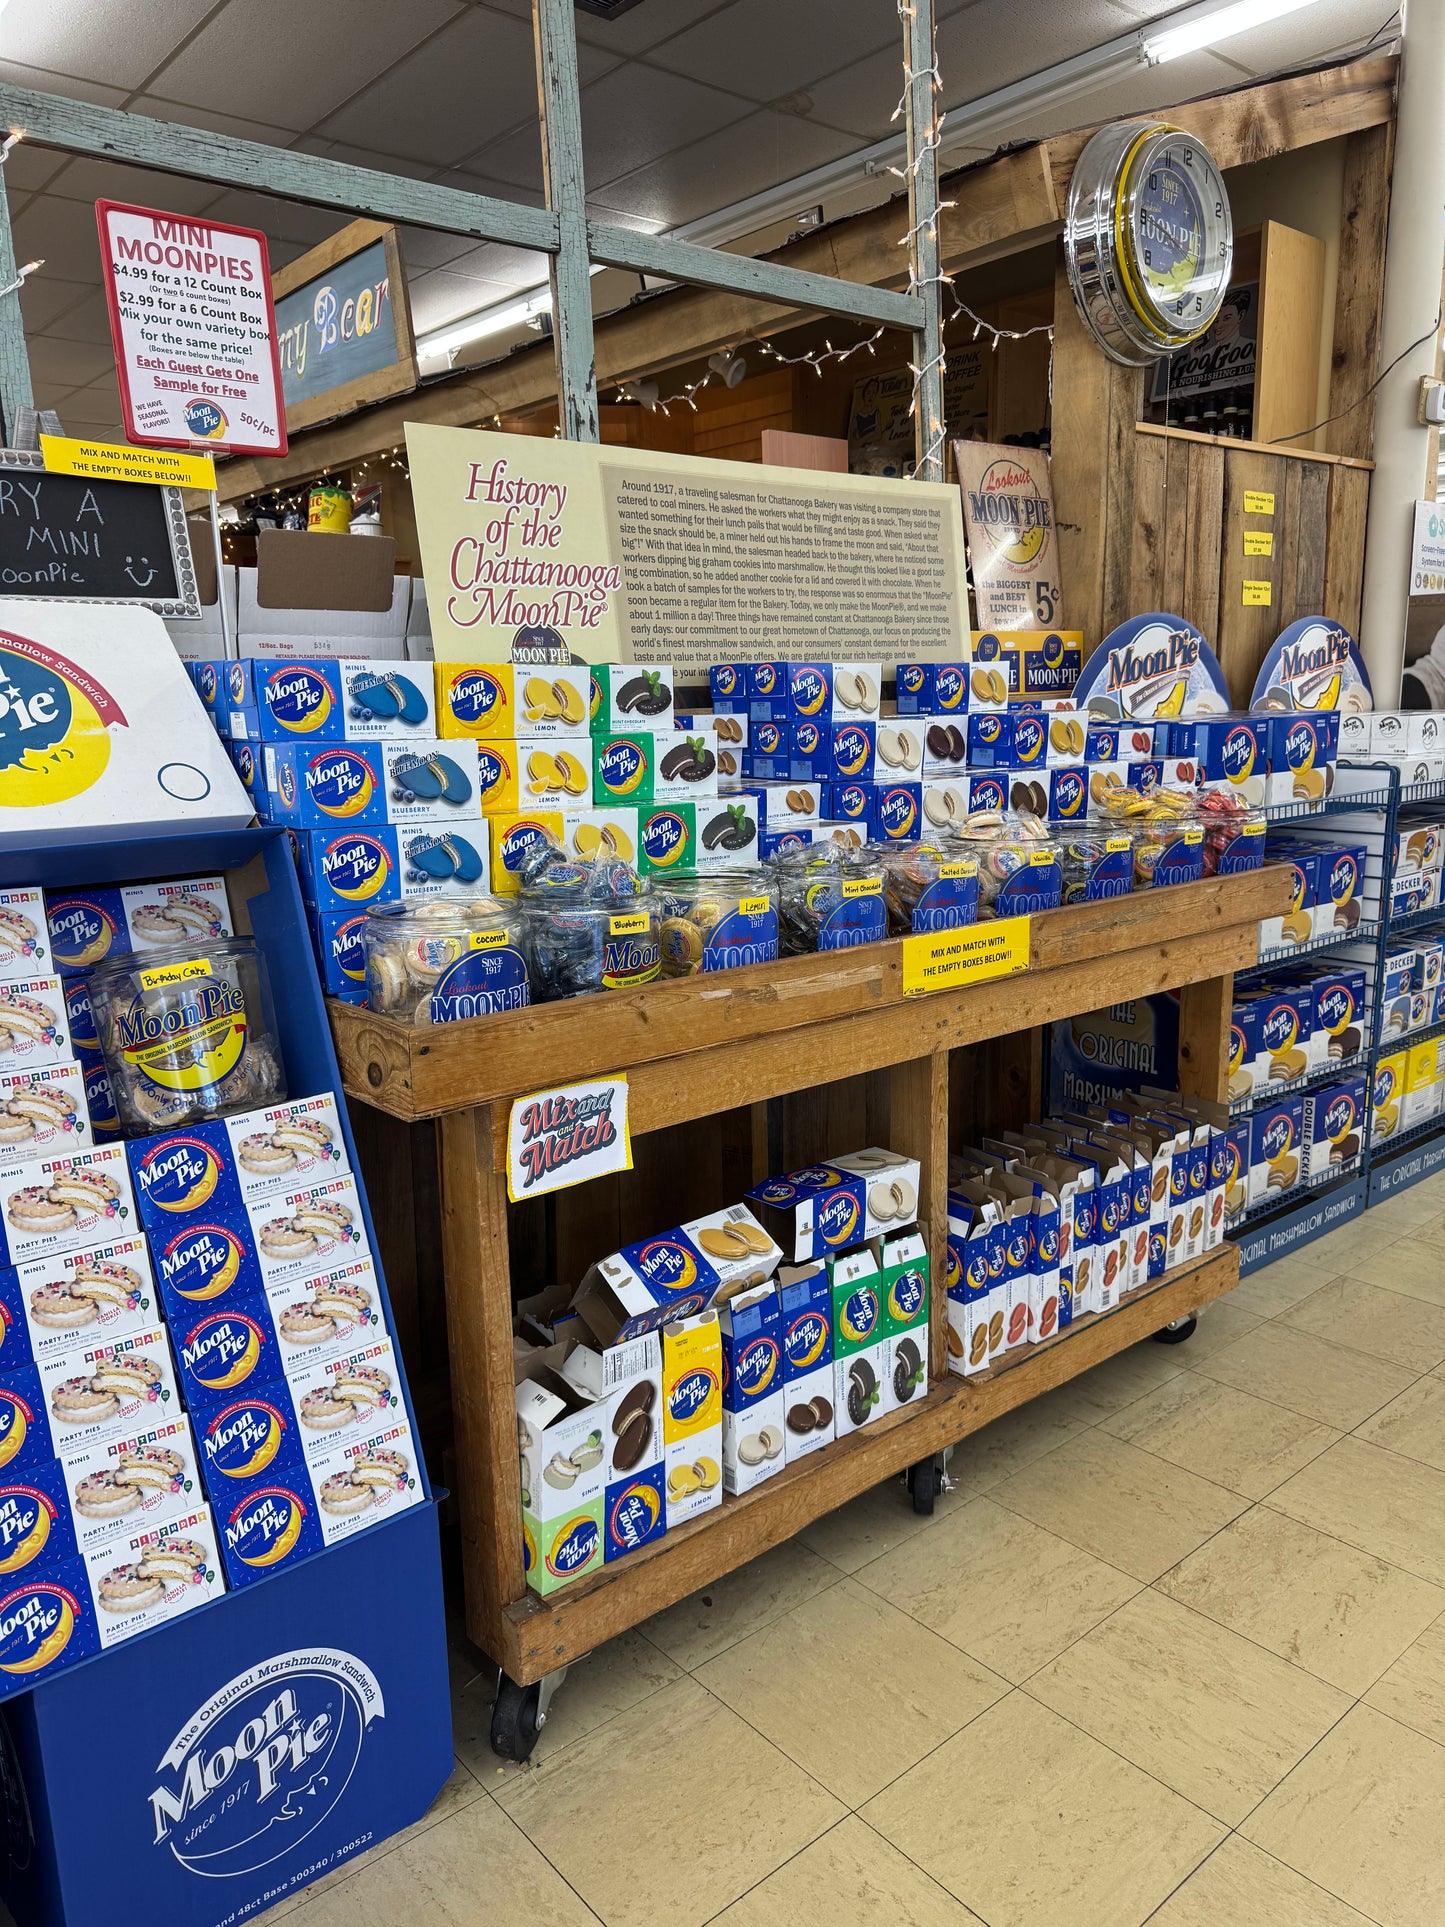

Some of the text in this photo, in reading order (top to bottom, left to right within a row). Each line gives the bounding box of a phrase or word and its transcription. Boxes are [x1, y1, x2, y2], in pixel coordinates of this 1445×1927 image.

[1183, 148, 1193, 168] 12
[1161, 174, 1180, 193] SINCE
[1162, 190, 1178, 206] 1917
[1215, 201, 1222, 218] 2
[1140, 208, 1147, 225] 9
[152, 219, 213, 249] MINI
[117, 236, 254, 282] MOONPIES
[113, 263, 262, 300] $4.99 for a 12 Count Box
[120, 291, 262, 325] $2.99 for a 6 Count Box
[150, 285, 162, 293] (Or
[163, 288, 178, 297] two
[186, 291, 207, 301] count
[208, 294, 231, 306] boxes)
[1176, 300, 1184, 316] 6
[1195, 297, 1202, 313] 5
[118, 306, 270, 340] Mix your own variety box
[314, 278, 389, 354] Bear
[140, 328, 253, 355] for the same price!
[148, 344, 173, 354] (Boxes
[188, 350, 210, 360] below
[225, 355, 245, 365] table)
[136, 355, 259, 382] Each Guest Gets One
[1178, 368, 1236, 387] NOURISHING
[153, 376, 247, 398] Sample for Free
[135, 400, 163, 411] WE HAVE
[137, 409, 168, 421] SEASONAL
[184, 405, 211, 422] Moon
[143, 418, 171, 430] FLAVORS!
[203, 417, 218, 429] Pie
[240, 412, 275, 436] 50¢/pc
[80, 447, 180, 466] MIX AND MATCH WITH
[72, 462, 191, 482] THE EMPTY BOXES BELOW!!
[986, 466, 1031, 492] Lookout
[464, 459, 567, 520] History
[622, 480, 651, 492] Around
[653, 483, 677, 496] 1917,
[678, 487, 684, 495] a
[685, 488, 719, 500] traveling
[720, 491, 755, 502] salesman
[757, 494, 767, 503] for
[768, 494, 813, 509] Chattanooga
[814, 499, 837, 511] Bakery
[839, 503, 852, 511] was
[853, 503, 876, 514] visiting
[883, 506, 911, 517] company
[912, 508, 927, 516] store
[929, 508, 941, 517] that
[76, 488, 104, 525] A
[26, 526, 100, 558] MINI
[486, 505, 562, 557] of the
[2, 562, 84, 583] oonPie
[450, 537, 620, 600] Chattanooga
[990, 592, 1026, 601] and BEST
[996, 580, 1031, 590] BIGGEST
[990, 604, 1027, 613] LUNCH in
[1106, 629, 1201, 693] MoonPie
[1281, 629, 1350, 684] MoonPie
[55, 660, 108, 708] Sandwich
[264, 676, 308, 705] Moon
[296, 690, 320, 710] Pie
[1396, 878, 1420, 892] DECKER
[931, 936, 1005, 959] MIX AND MATCH WITH
[481, 957, 503, 968] SINCE
[485, 966, 501, 976] 1917
[923, 950, 1012, 977] THE EMPTY BOXES BELOW!!
[1390, 955, 1414, 971] DECKER
[143, 966, 206, 987] Birthday Cake
[444, 980, 488, 996] Lookout
[116, 981, 245, 1049] MoonPie
[1263, 1010, 1287, 1039] Moon
[136, 1018, 233, 1061] THE ORIGINAL MARSHMALLOW SANDWICH
[1278, 1020, 1294, 1041] Pie
[1079, 1031, 1158, 1075] ORIGINAL
[230, 1118, 250, 1127] MINIS
[265, 1097, 333, 1123] BIRTHDAY
[520, 1088, 615, 1144] Mix and
[520, 1111, 616, 1188] Match
[1301, 1100, 1313, 1181] DOUBLE DECKER
[137, 1148, 189, 1191] Moon
[175, 1160, 204, 1188] Pie
[247, 1177, 282, 1191] PARTY PIES
[666, 1375, 701, 1411] Moon
[689, 1383, 708, 1407] Pie
[175, 1654, 375, 1752] The Original Marshmallow Sandwich
[148, 1688, 300, 1846] Moon
[254, 1712, 333, 1804] Pie
[184, 1780, 250, 1846] since 1917
[237, 1831, 374, 1917] 48ct Base 300340 300522
